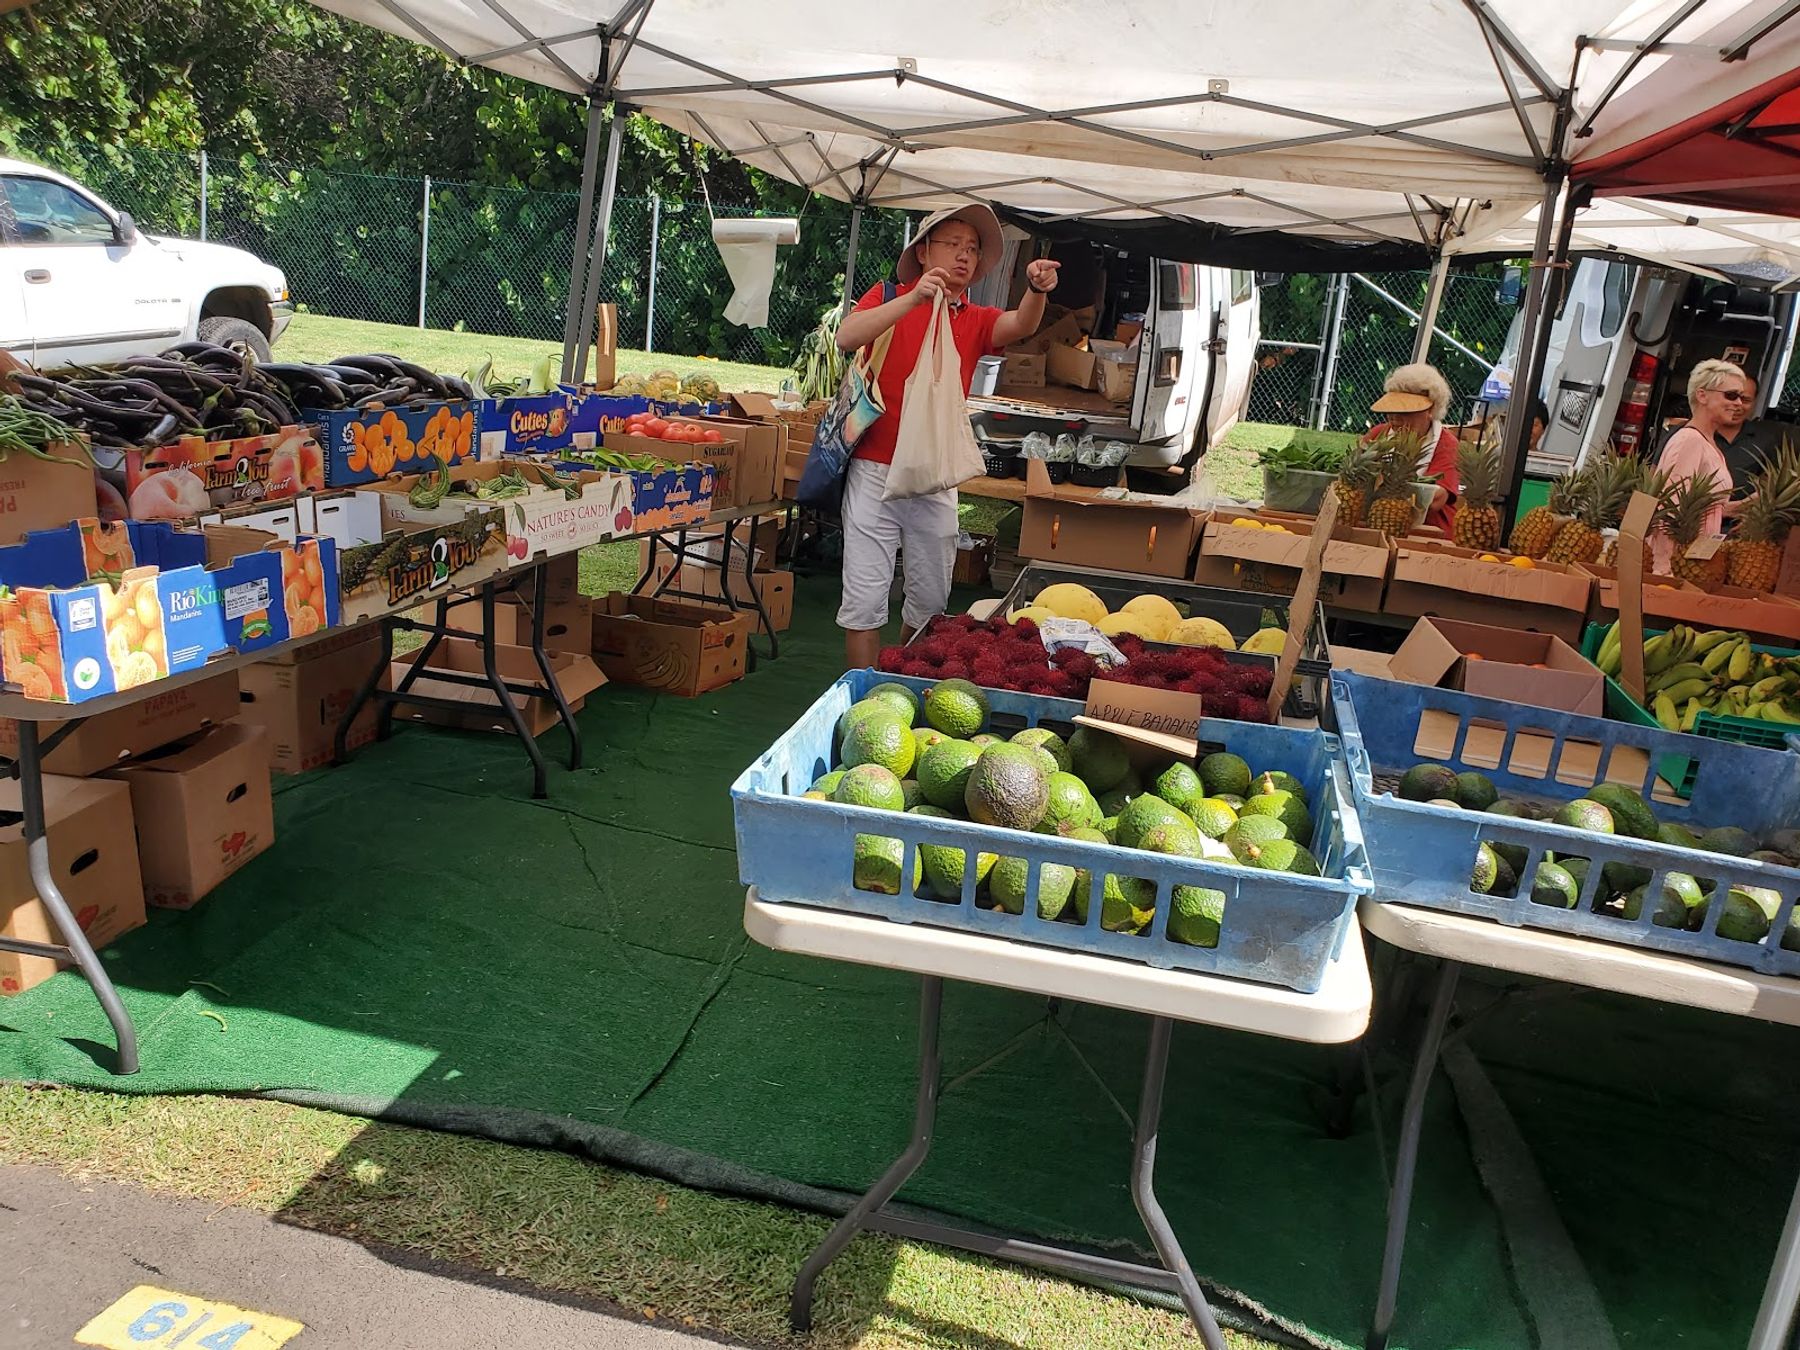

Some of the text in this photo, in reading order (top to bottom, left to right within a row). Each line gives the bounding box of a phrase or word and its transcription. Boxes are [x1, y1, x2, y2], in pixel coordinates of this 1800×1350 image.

[511, 410, 548, 434] Cuties
[600, 414, 626, 434] Cutie
[527, 504, 610, 534] NATURE'S CANDY
[145, 689, 188, 714] PAPAYA
[1090, 703, 1199, 736] APPLE BANANA
